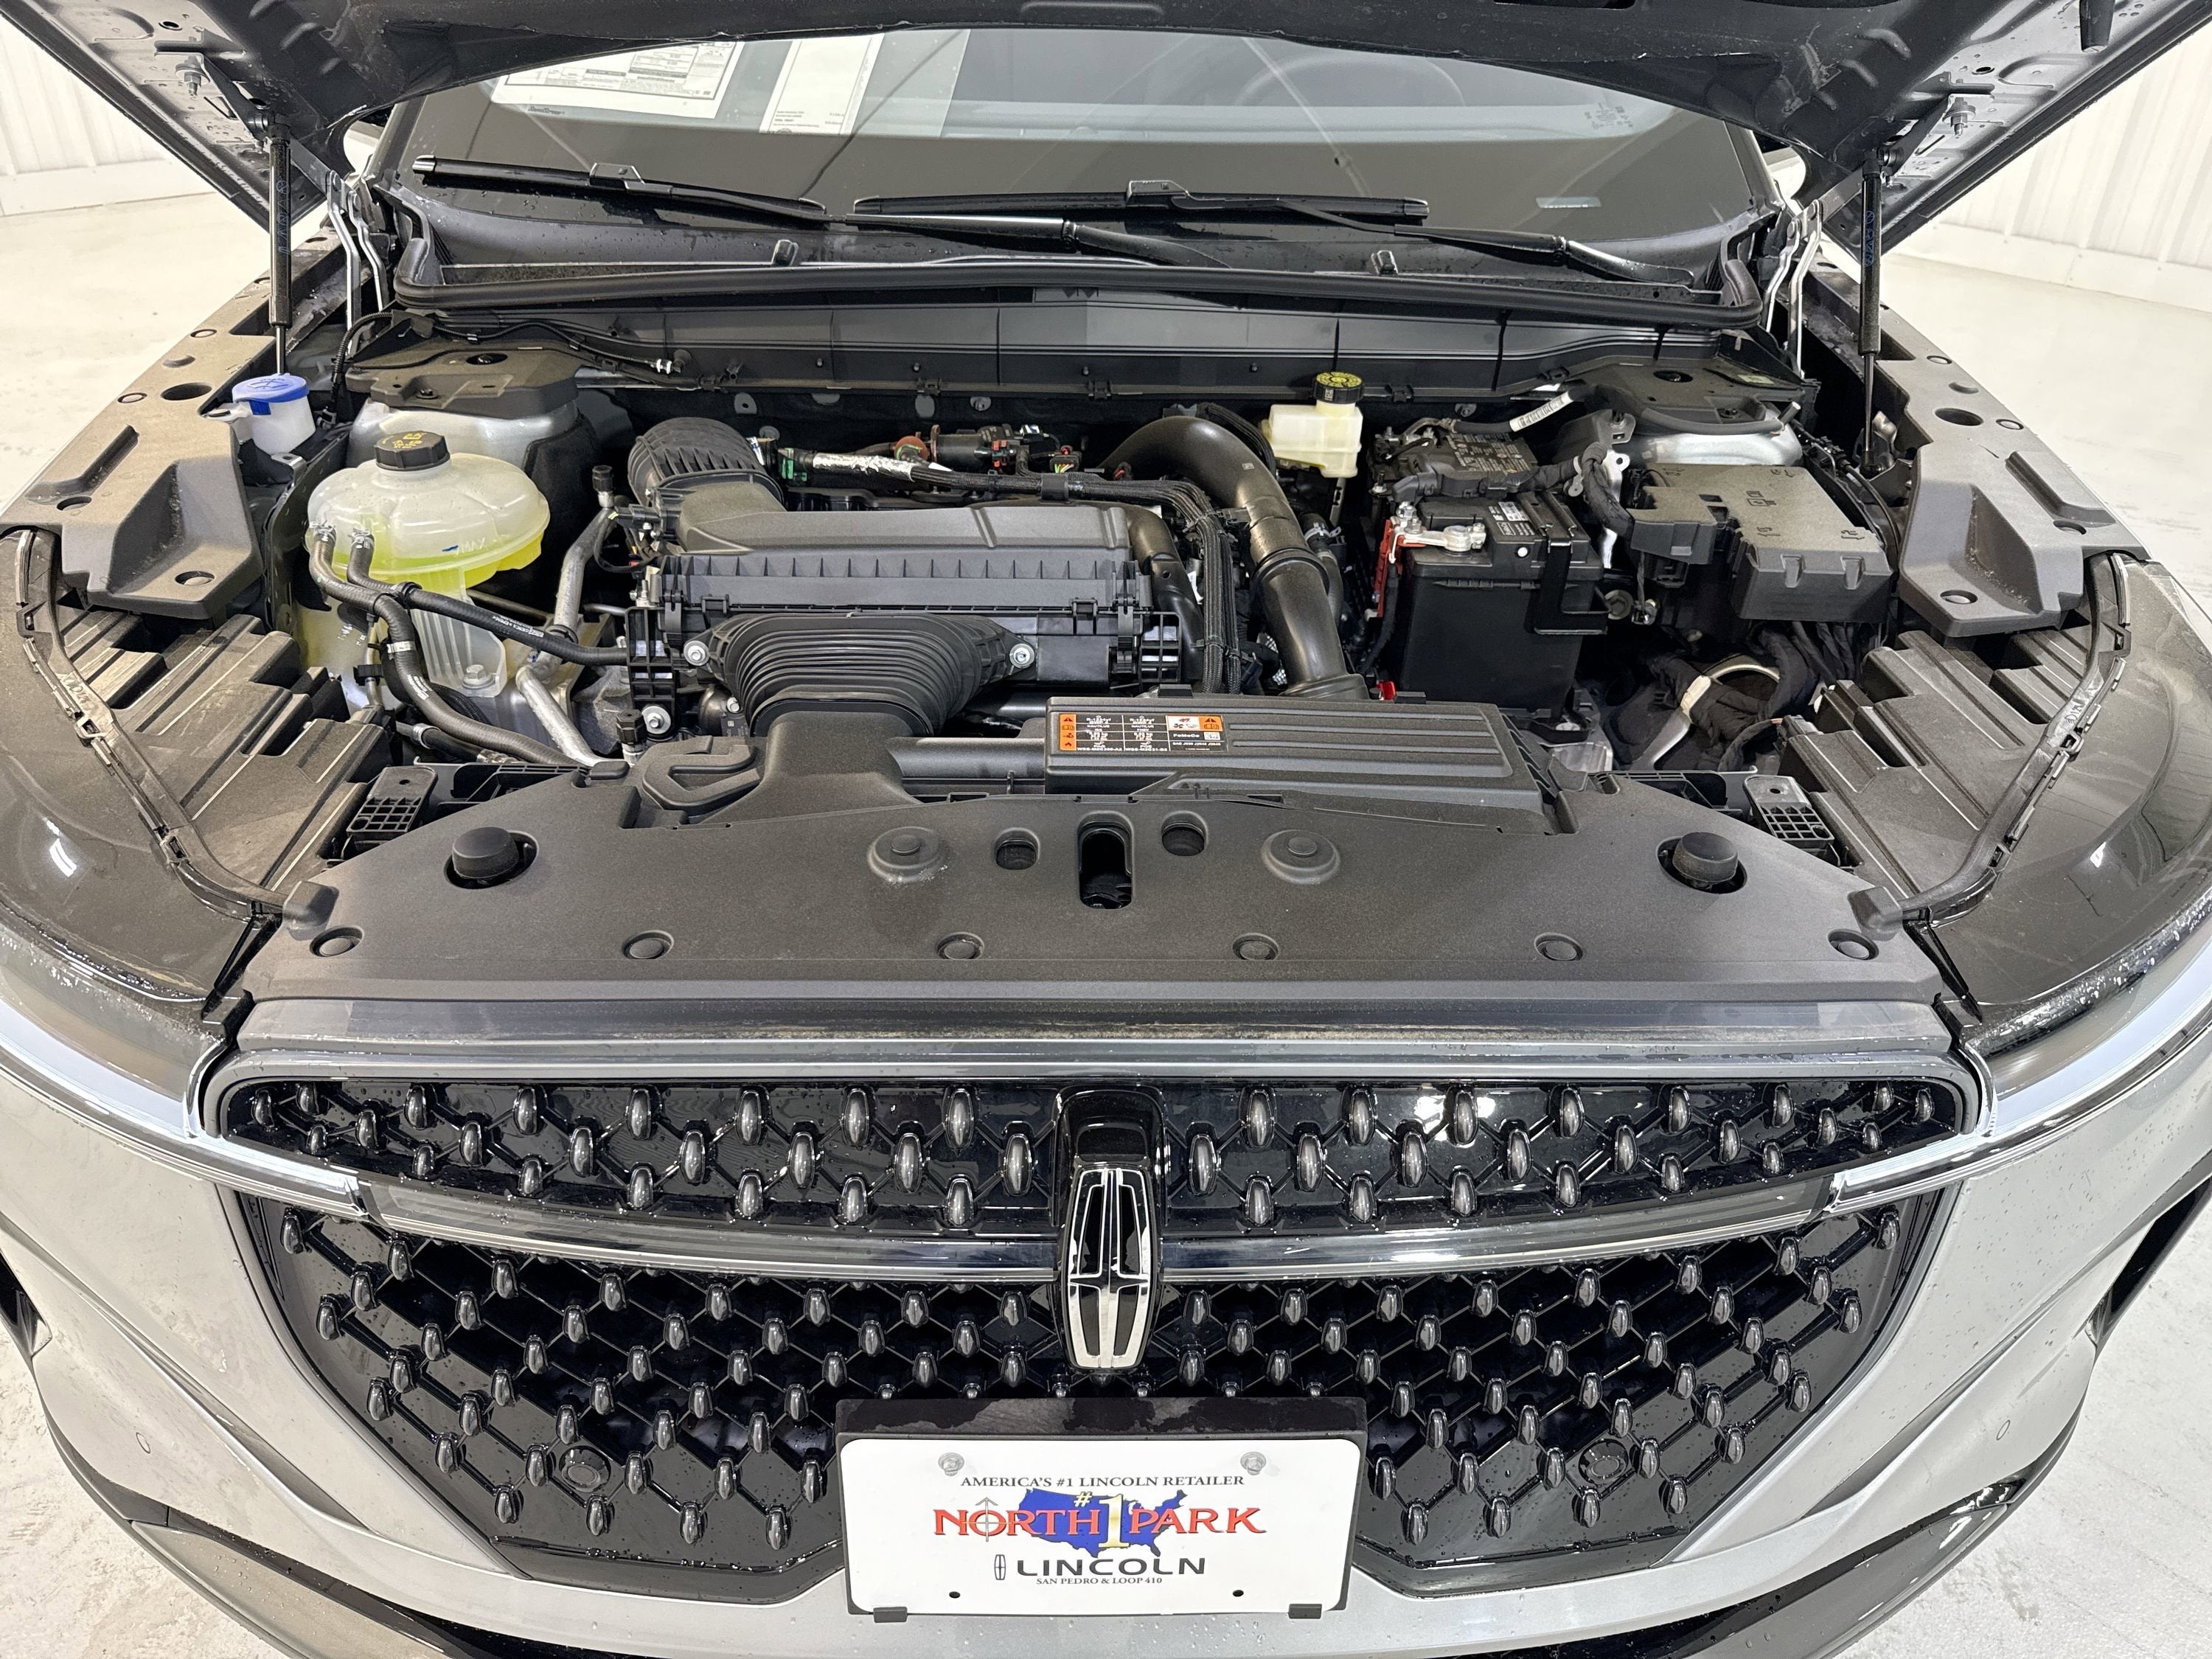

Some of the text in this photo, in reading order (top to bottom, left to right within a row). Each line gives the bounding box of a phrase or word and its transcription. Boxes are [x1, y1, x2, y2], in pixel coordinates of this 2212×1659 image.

[961, 1475, 1245, 1487] AMERICA'S #1 LINCOLN RETAILER
[933, 1508, 1267, 1536] NORTH PARK
[1017, 1557, 1206, 1576] LINCOLN
